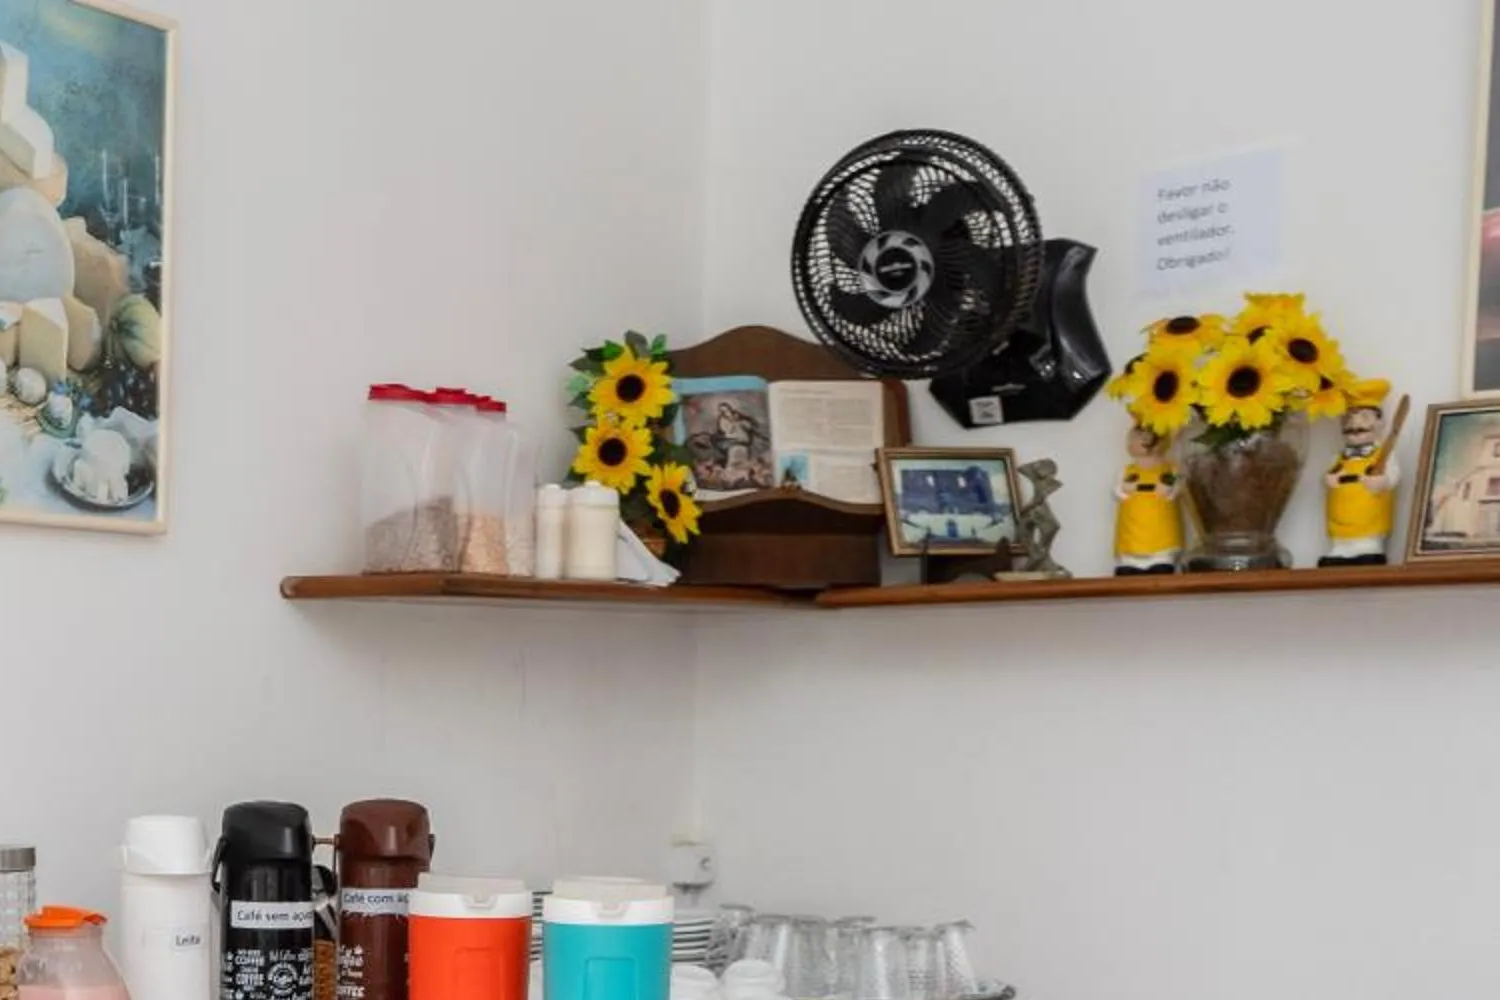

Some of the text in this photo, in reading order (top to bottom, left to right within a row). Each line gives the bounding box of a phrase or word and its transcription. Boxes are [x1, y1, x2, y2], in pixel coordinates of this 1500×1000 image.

[1157, 178, 1232, 199] Favor não
[1217, 202, 1229, 213] o
[367, 894, 394, 904] com
[237, 909, 262, 921] Café
[265, 912, 289, 922] sem
